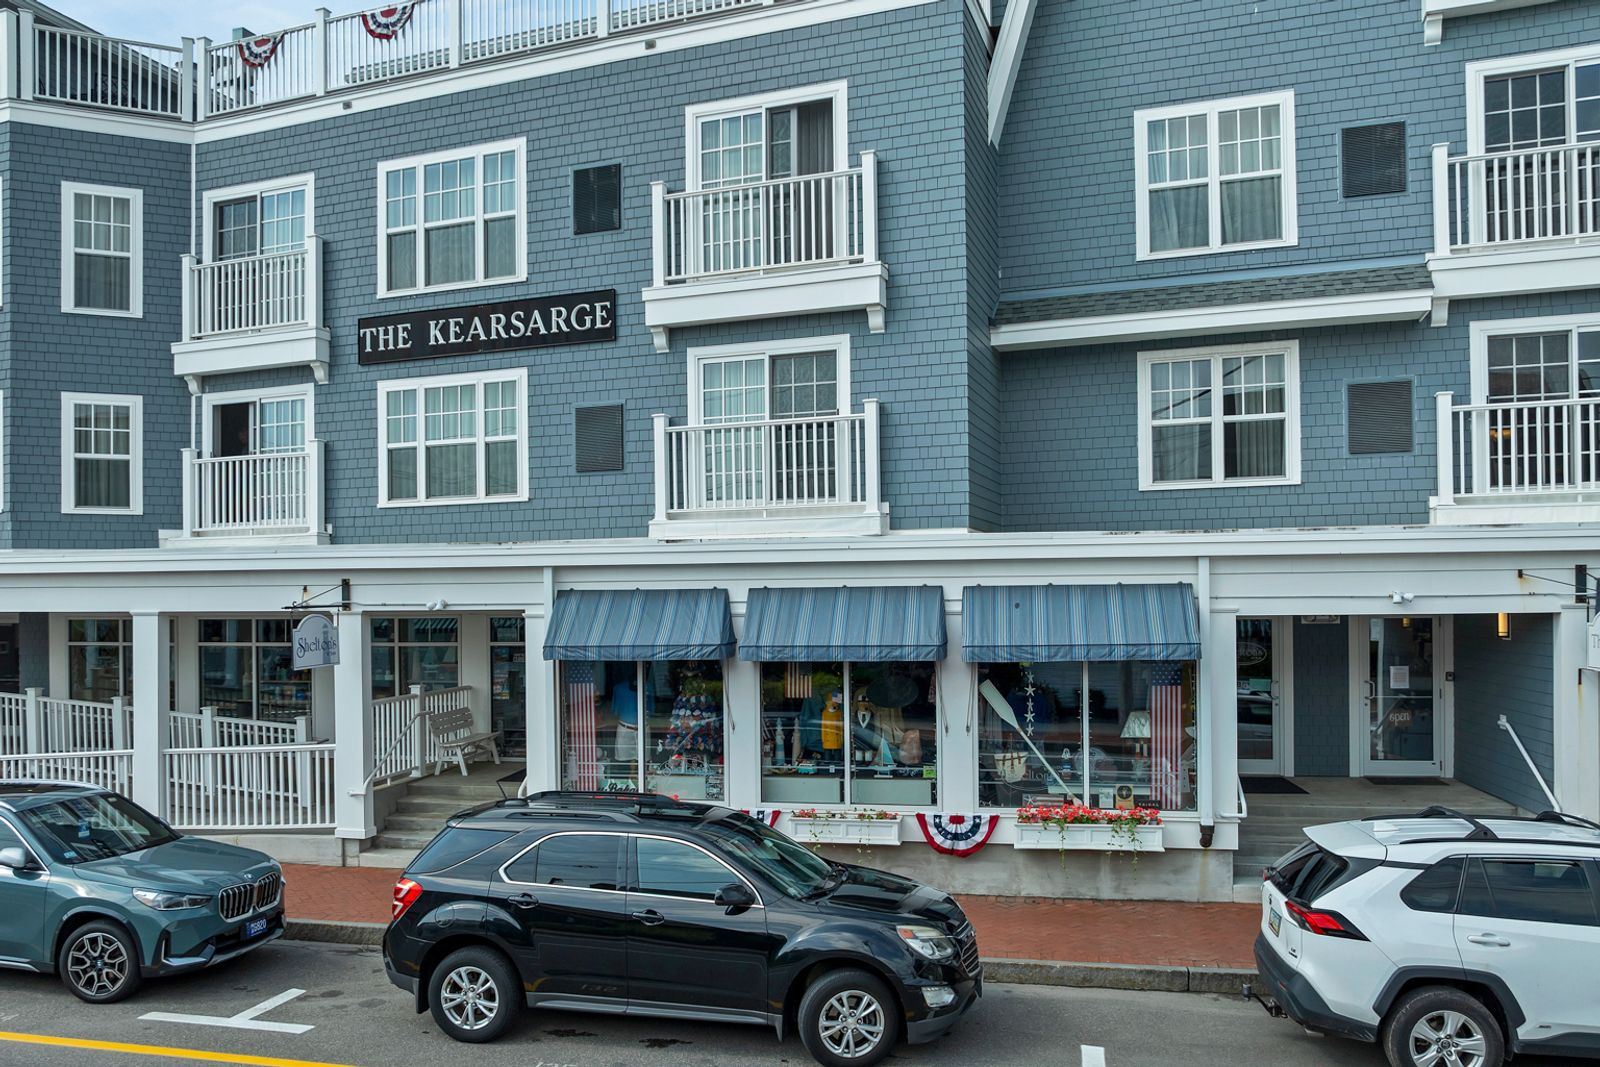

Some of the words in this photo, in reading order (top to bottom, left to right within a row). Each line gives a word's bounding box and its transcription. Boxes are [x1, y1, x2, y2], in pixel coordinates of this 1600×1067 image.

[360, 323, 412, 353] THE
[428, 301, 612, 346] KEARSARGE
[296, 637, 337, 659] Shelton's
